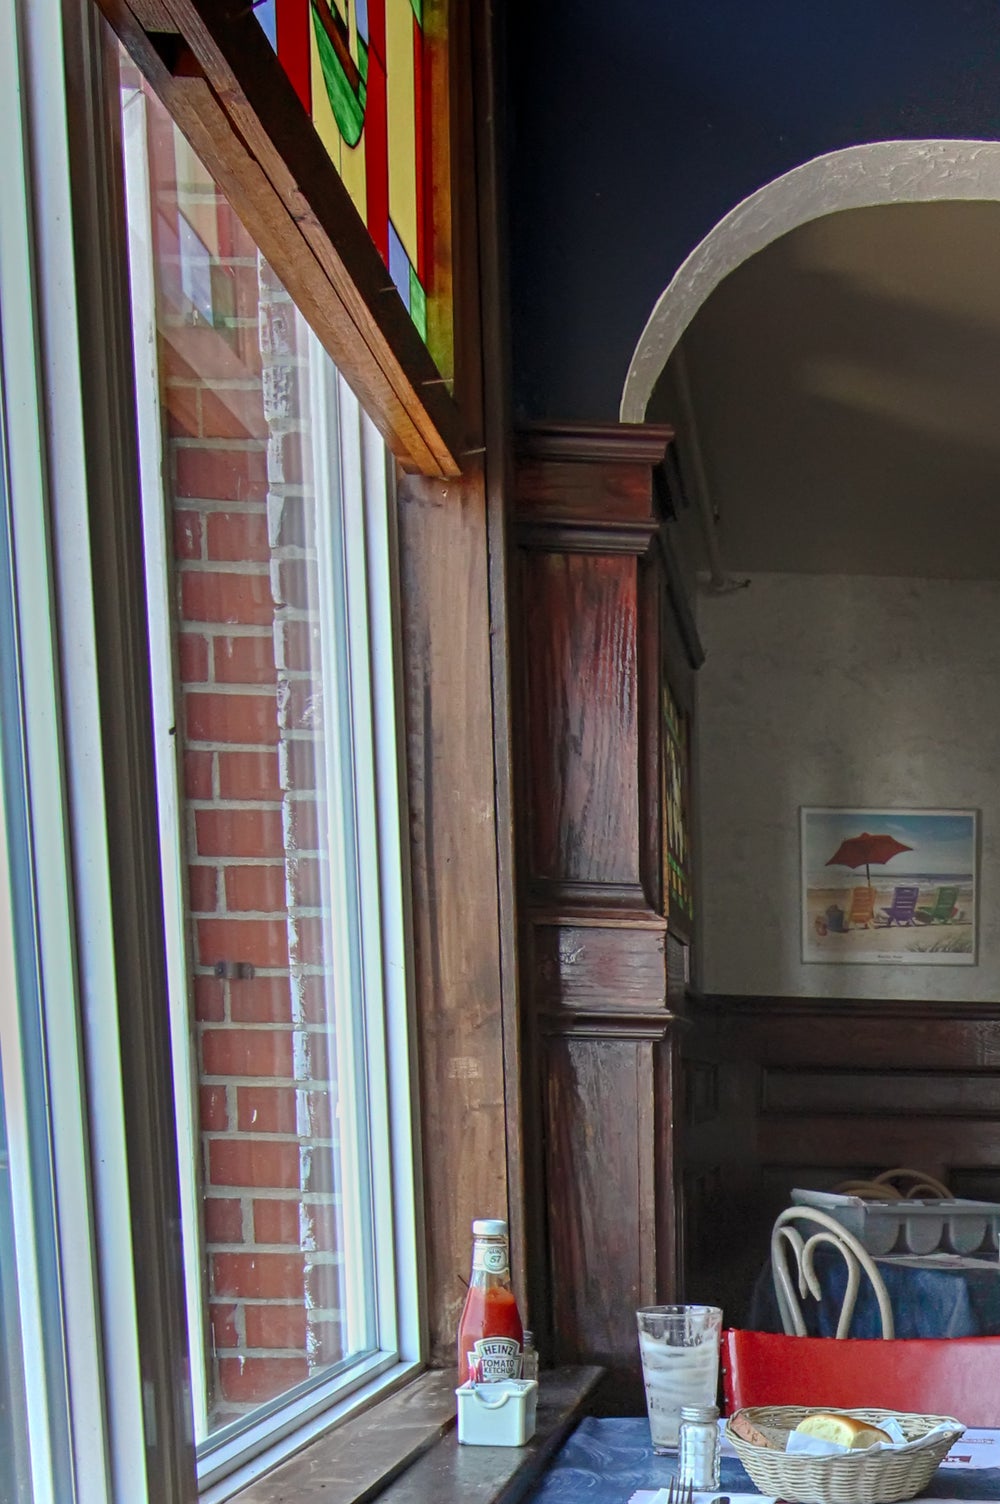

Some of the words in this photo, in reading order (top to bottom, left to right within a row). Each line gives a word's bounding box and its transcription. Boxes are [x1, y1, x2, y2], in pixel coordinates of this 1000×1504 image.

[490, 1255, 502, 1264] 57
[483, 1344, 514, 1356] HEINZ
[482, 1359, 515, 1368] TOMATO
